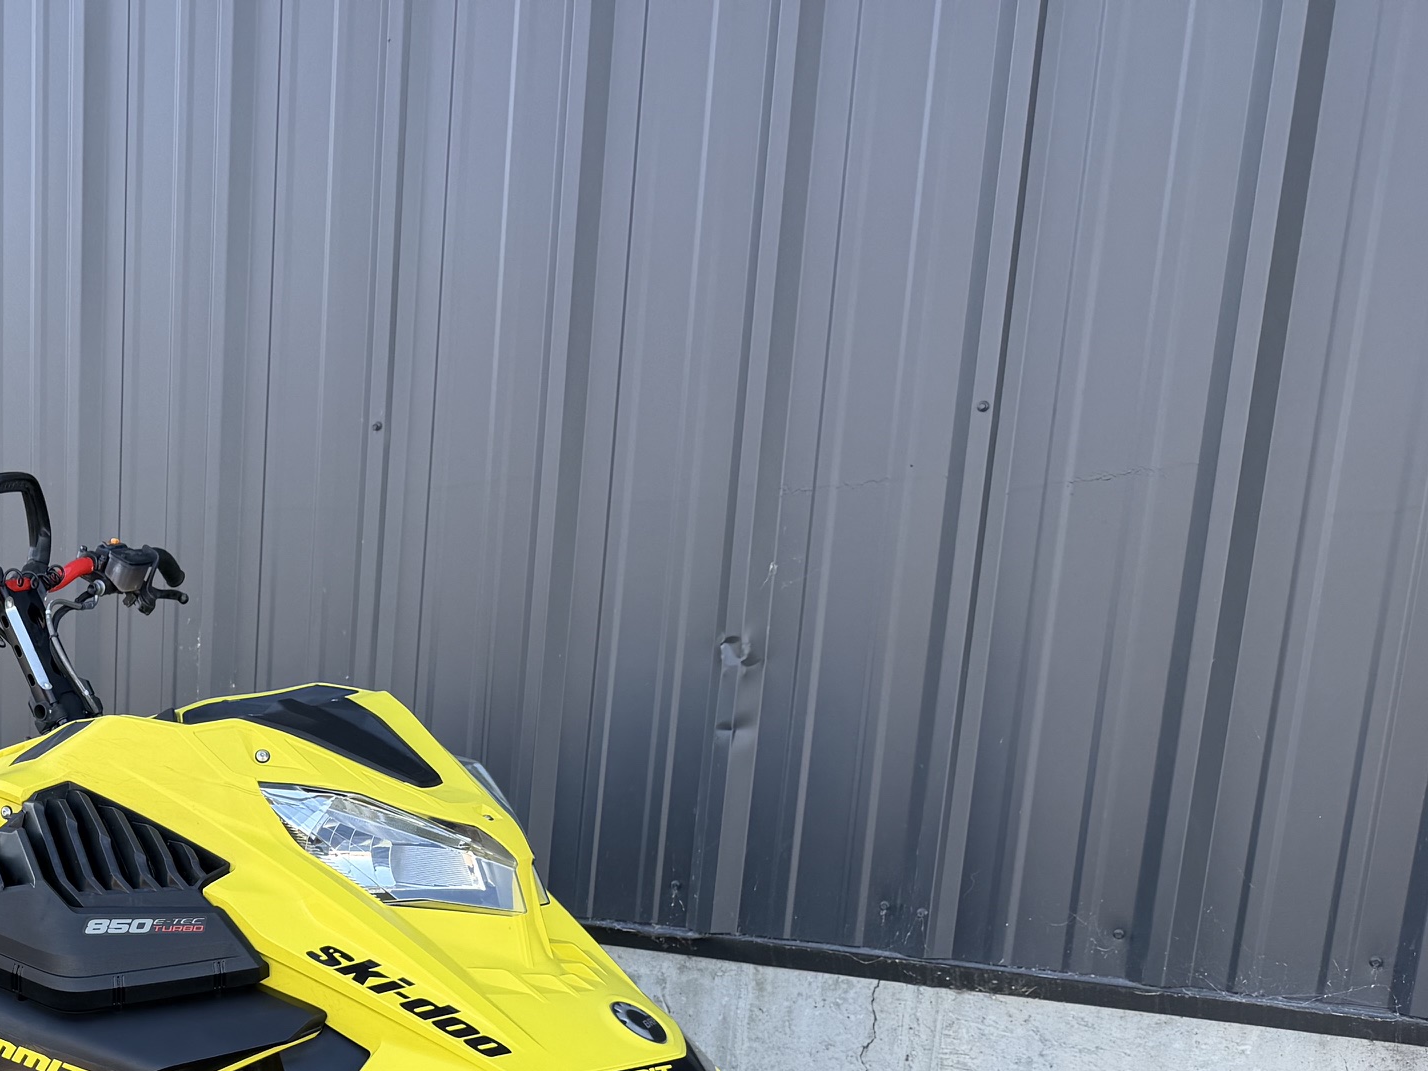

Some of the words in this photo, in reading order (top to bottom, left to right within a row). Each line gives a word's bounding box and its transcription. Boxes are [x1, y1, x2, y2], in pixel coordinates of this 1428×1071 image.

[84, 918, 154, 934] 850
[153, 917, 205, 925] E-TEC
[153, 925, 205, 933] TURBO
[305, 945, 512, 1058] ski-doo
